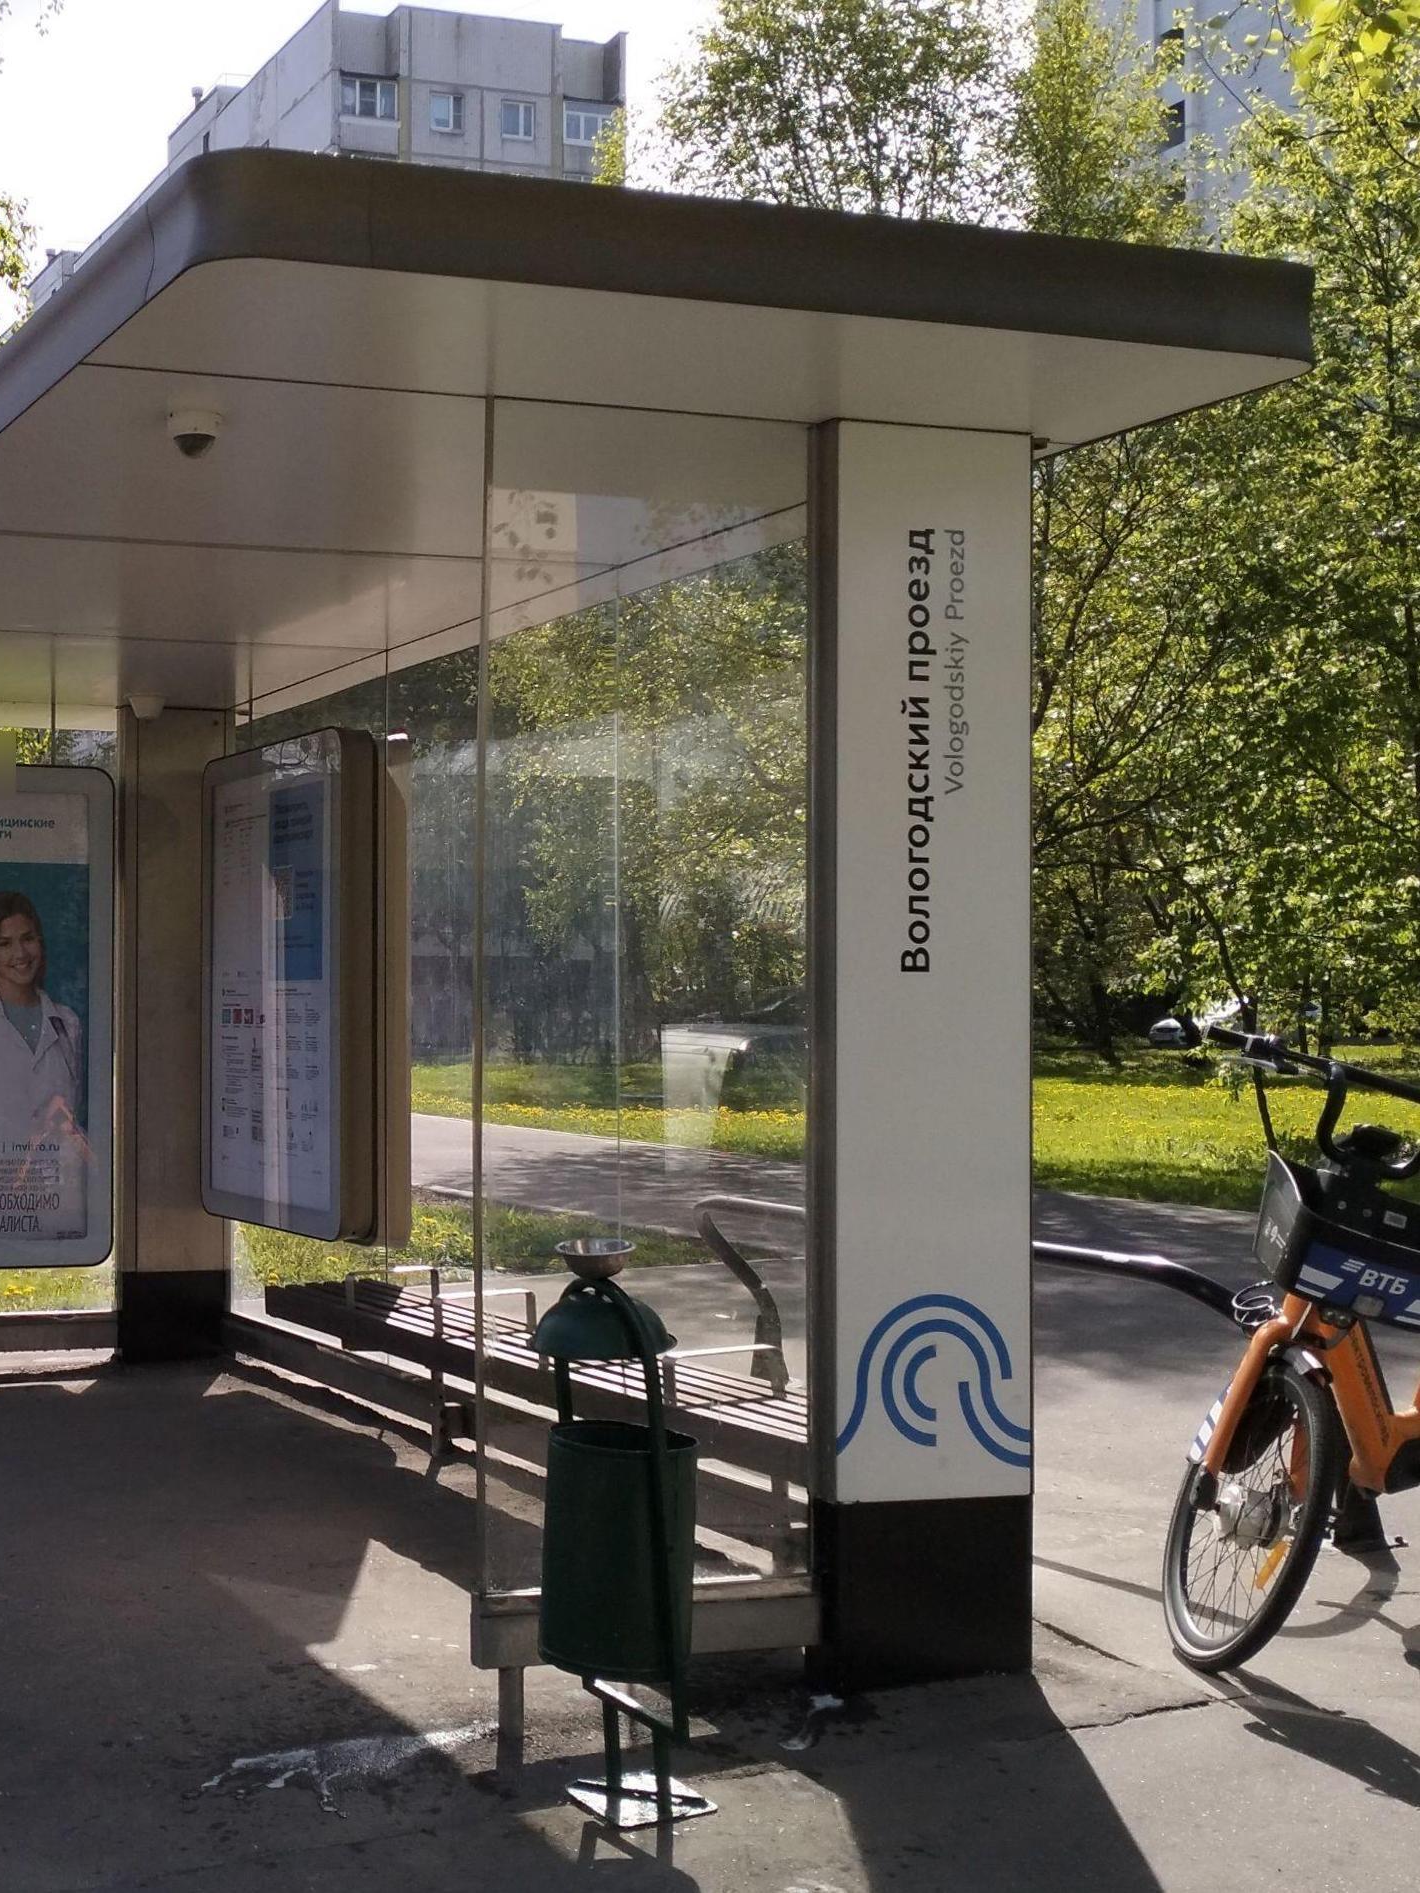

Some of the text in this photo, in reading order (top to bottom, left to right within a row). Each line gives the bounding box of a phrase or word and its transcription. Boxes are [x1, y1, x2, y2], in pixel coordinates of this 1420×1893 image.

[944, 528, 970, 795] Vologodskiy Proezd
[901, 528, 937, 974] Вологодский проезд
[12, 1140, 60, 1152] inviro.ru
[1359, 1268, 1409, 1295] ВТБ
